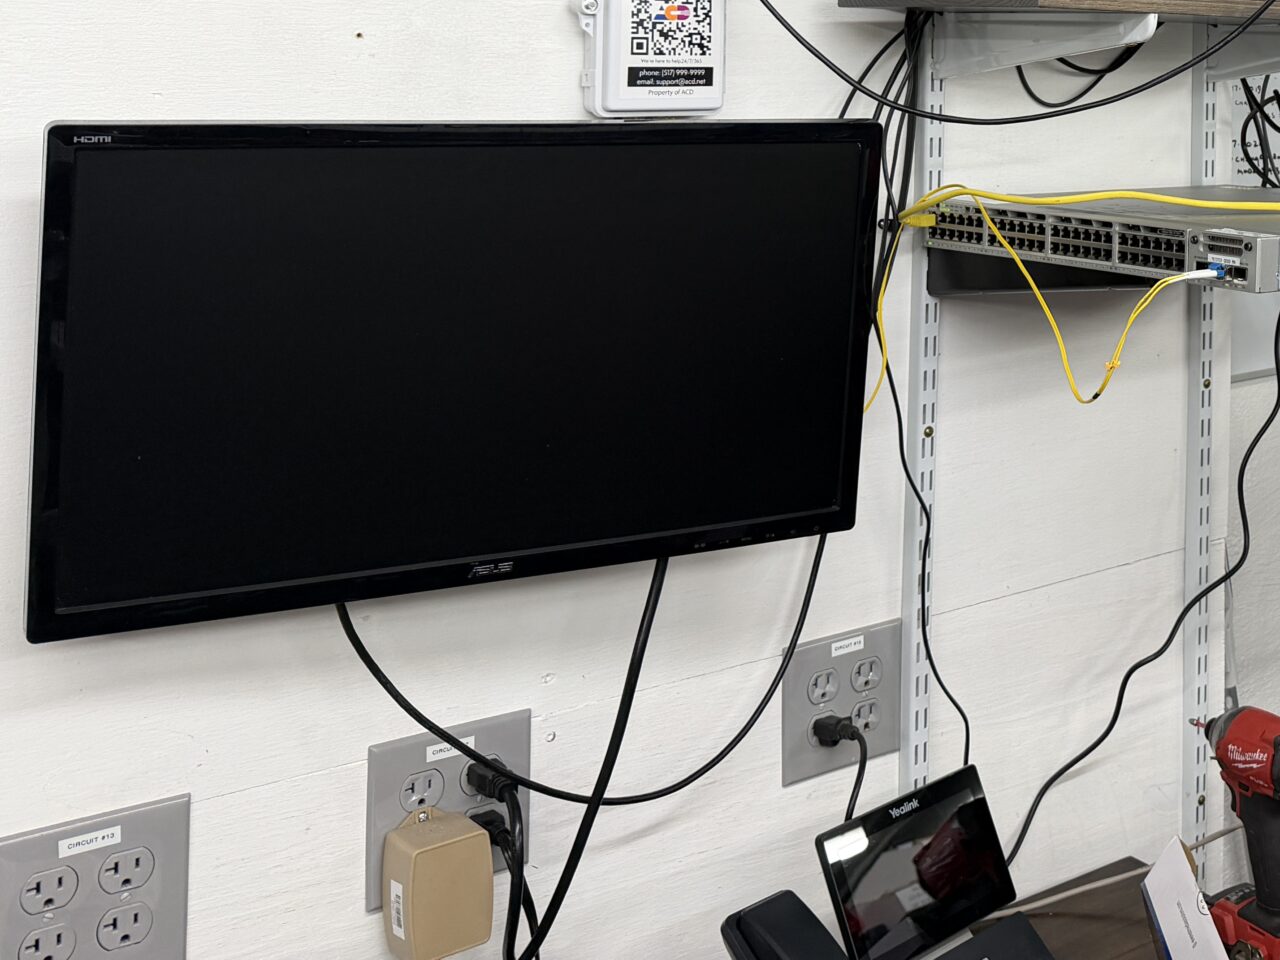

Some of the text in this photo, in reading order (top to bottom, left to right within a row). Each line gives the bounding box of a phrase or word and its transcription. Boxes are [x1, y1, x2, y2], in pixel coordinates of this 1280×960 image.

[639, 69, 660, 77] phone:
[661, 69, 675, 77] (517)
[655, 78, 706, 86] support@acd.net
[648, 89, 673, 97] Property
[73, 135, 112, 144] HDMI
[1227, 743, 1268, 762] Milwaukee
[888, 798, 920, 819] Yealink
[67, 836, 99, 850] CIRCUIT
